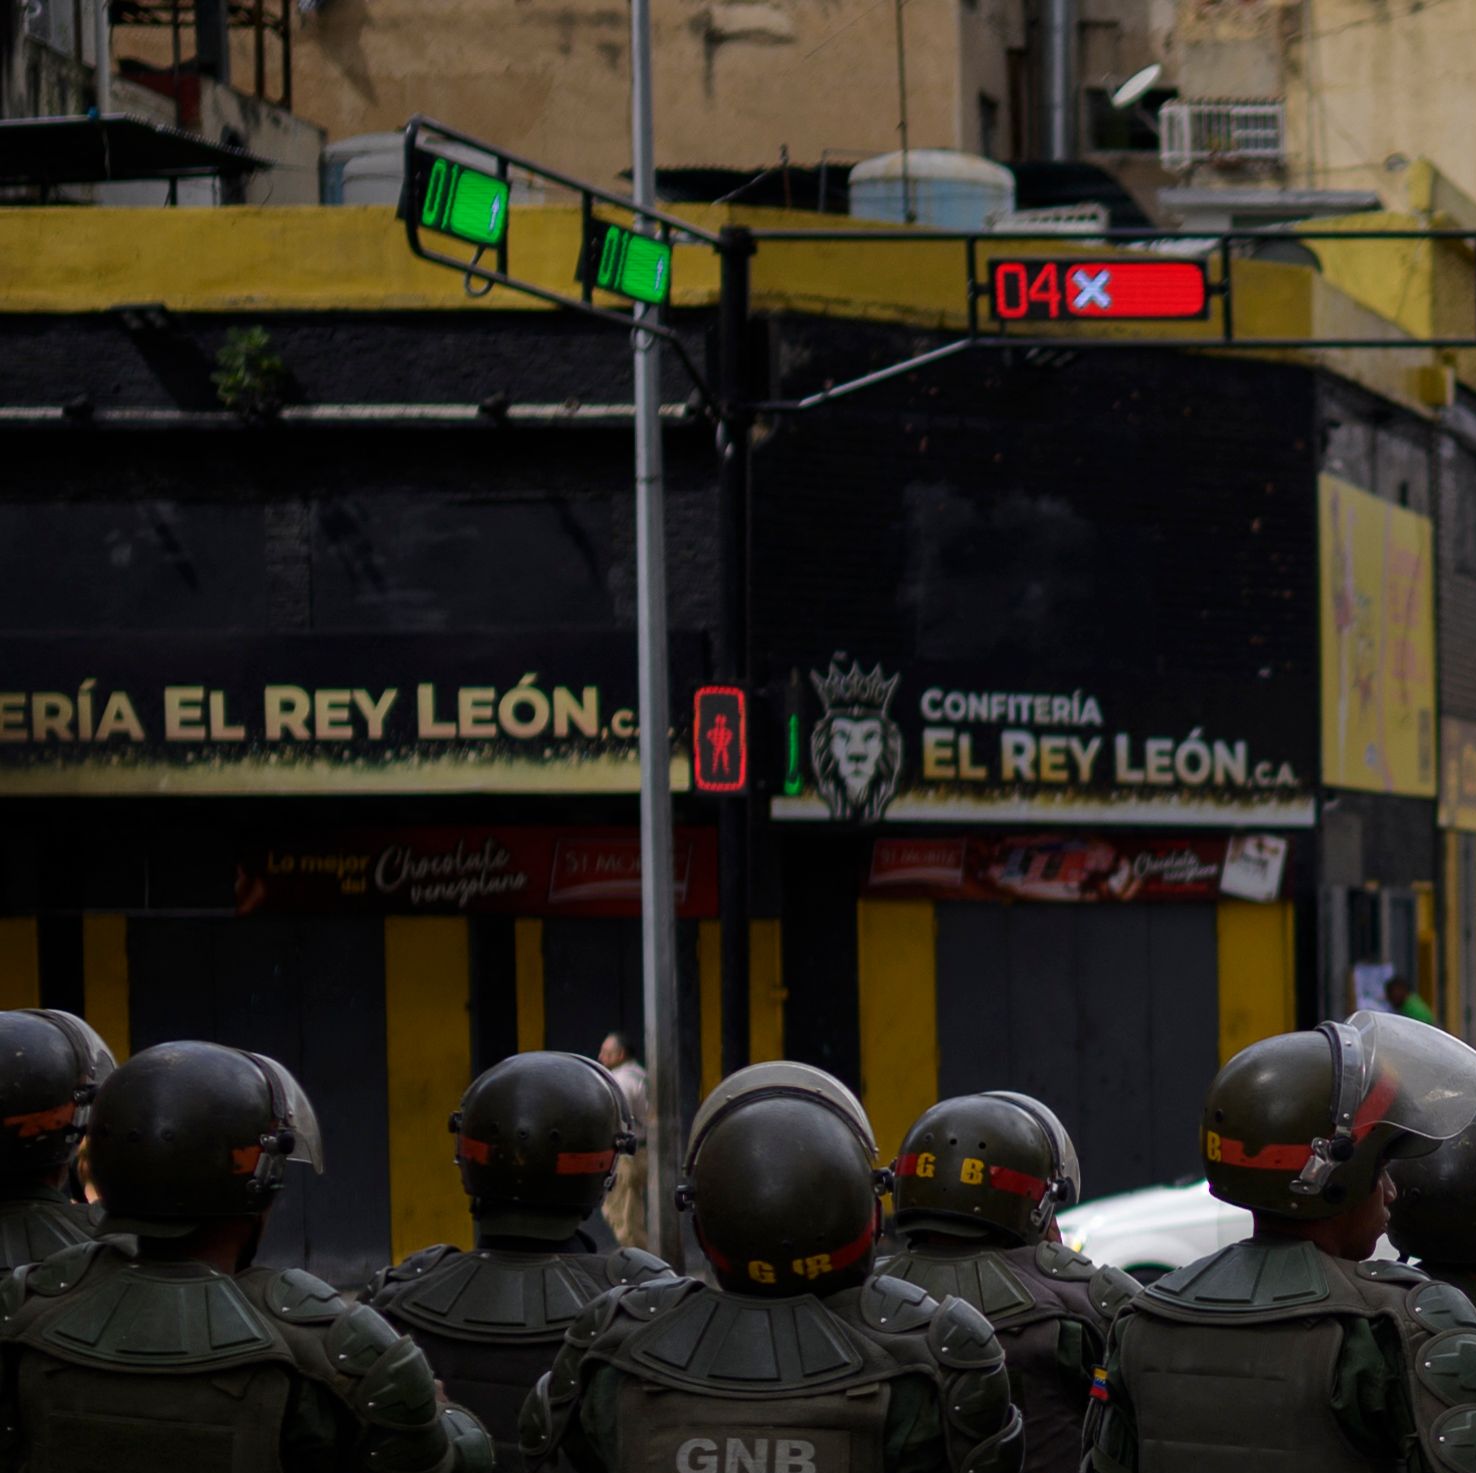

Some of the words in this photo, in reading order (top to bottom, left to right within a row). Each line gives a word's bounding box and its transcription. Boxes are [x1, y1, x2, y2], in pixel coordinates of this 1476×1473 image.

[995, 262, 1062, 319] 04
[164, 685, 246, 741] EL
[264, 684, 398, 741] REY
[920, 688, 1103, 726] CONFITERÍA
[922, 727, 987, 780] EL
[1000, 729, 1103, 784] REY
[301, 849, 370, 877] mejor
[373, 835, 511, 894] Chocolate
